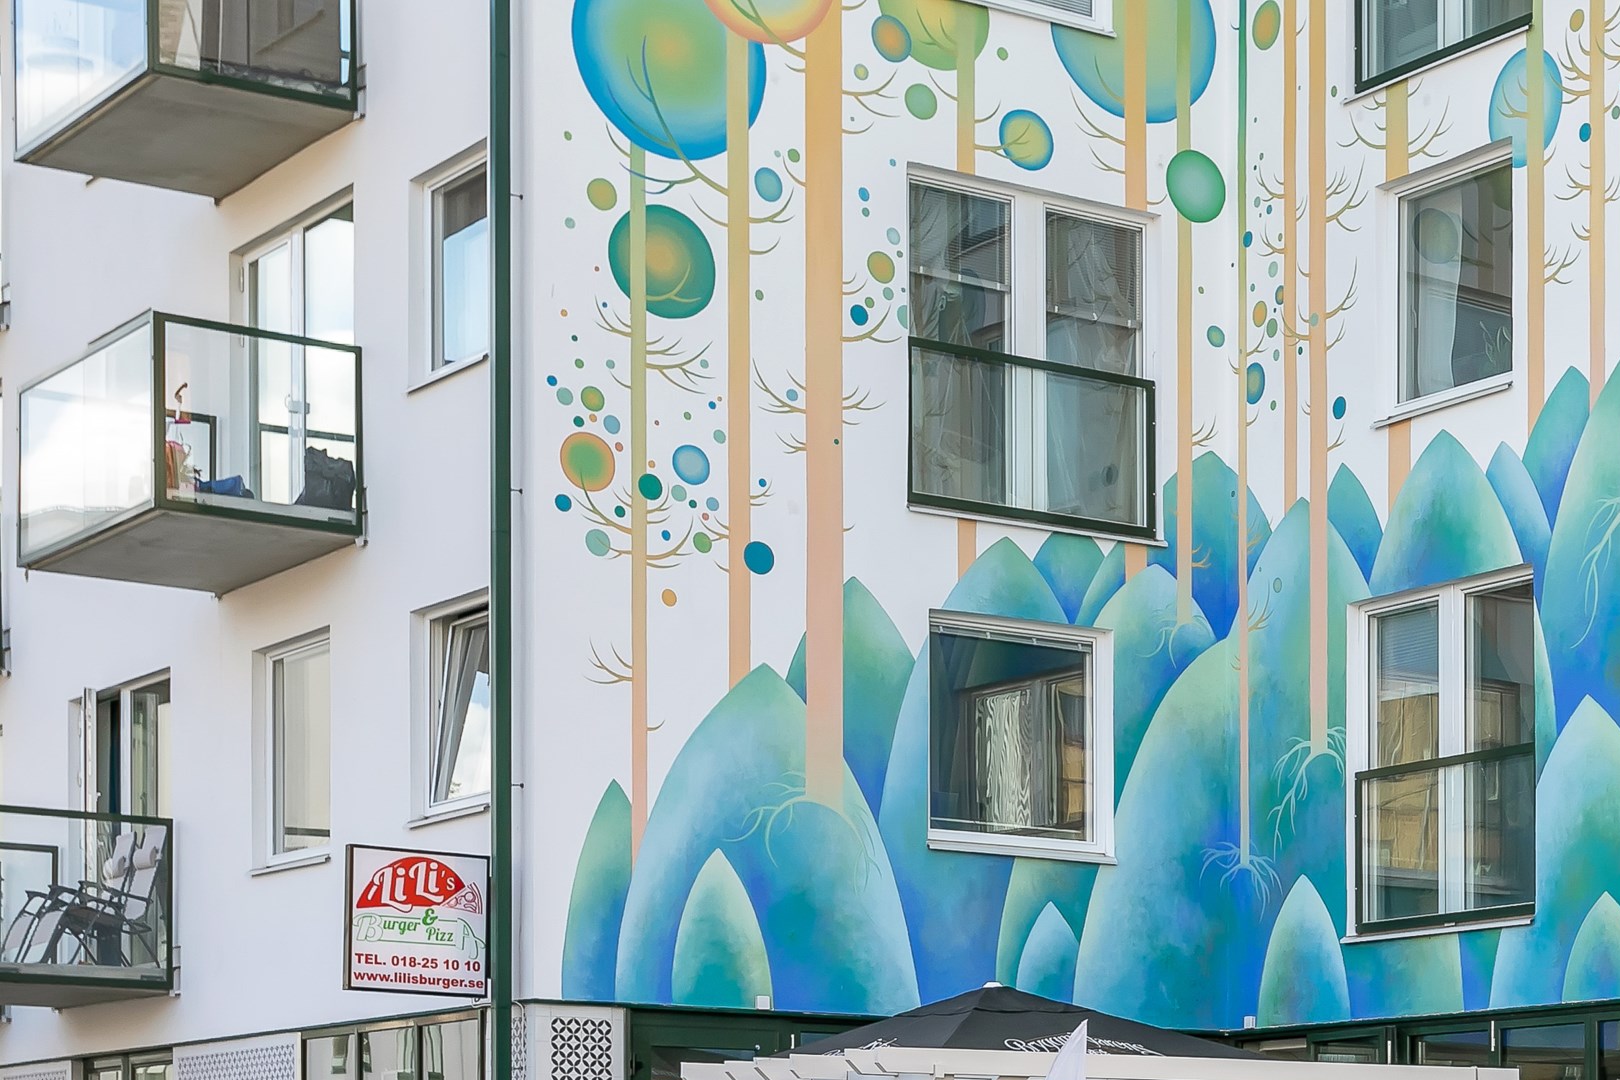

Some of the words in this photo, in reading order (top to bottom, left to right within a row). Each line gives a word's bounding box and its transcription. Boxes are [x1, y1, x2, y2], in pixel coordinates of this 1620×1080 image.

[370, 861, 456, 913] LiLi's
[353, 913, 420, 942] Burger
[421, 908, 438, 926] &
[354, 953, 387, 966] TEL.
[391, 955, 439, 970] 018-25
[443, 959, 460, 971] 10
[464, 961, 481, 972] 10
[353, 971, 484, 990] www.lilisburger.se
